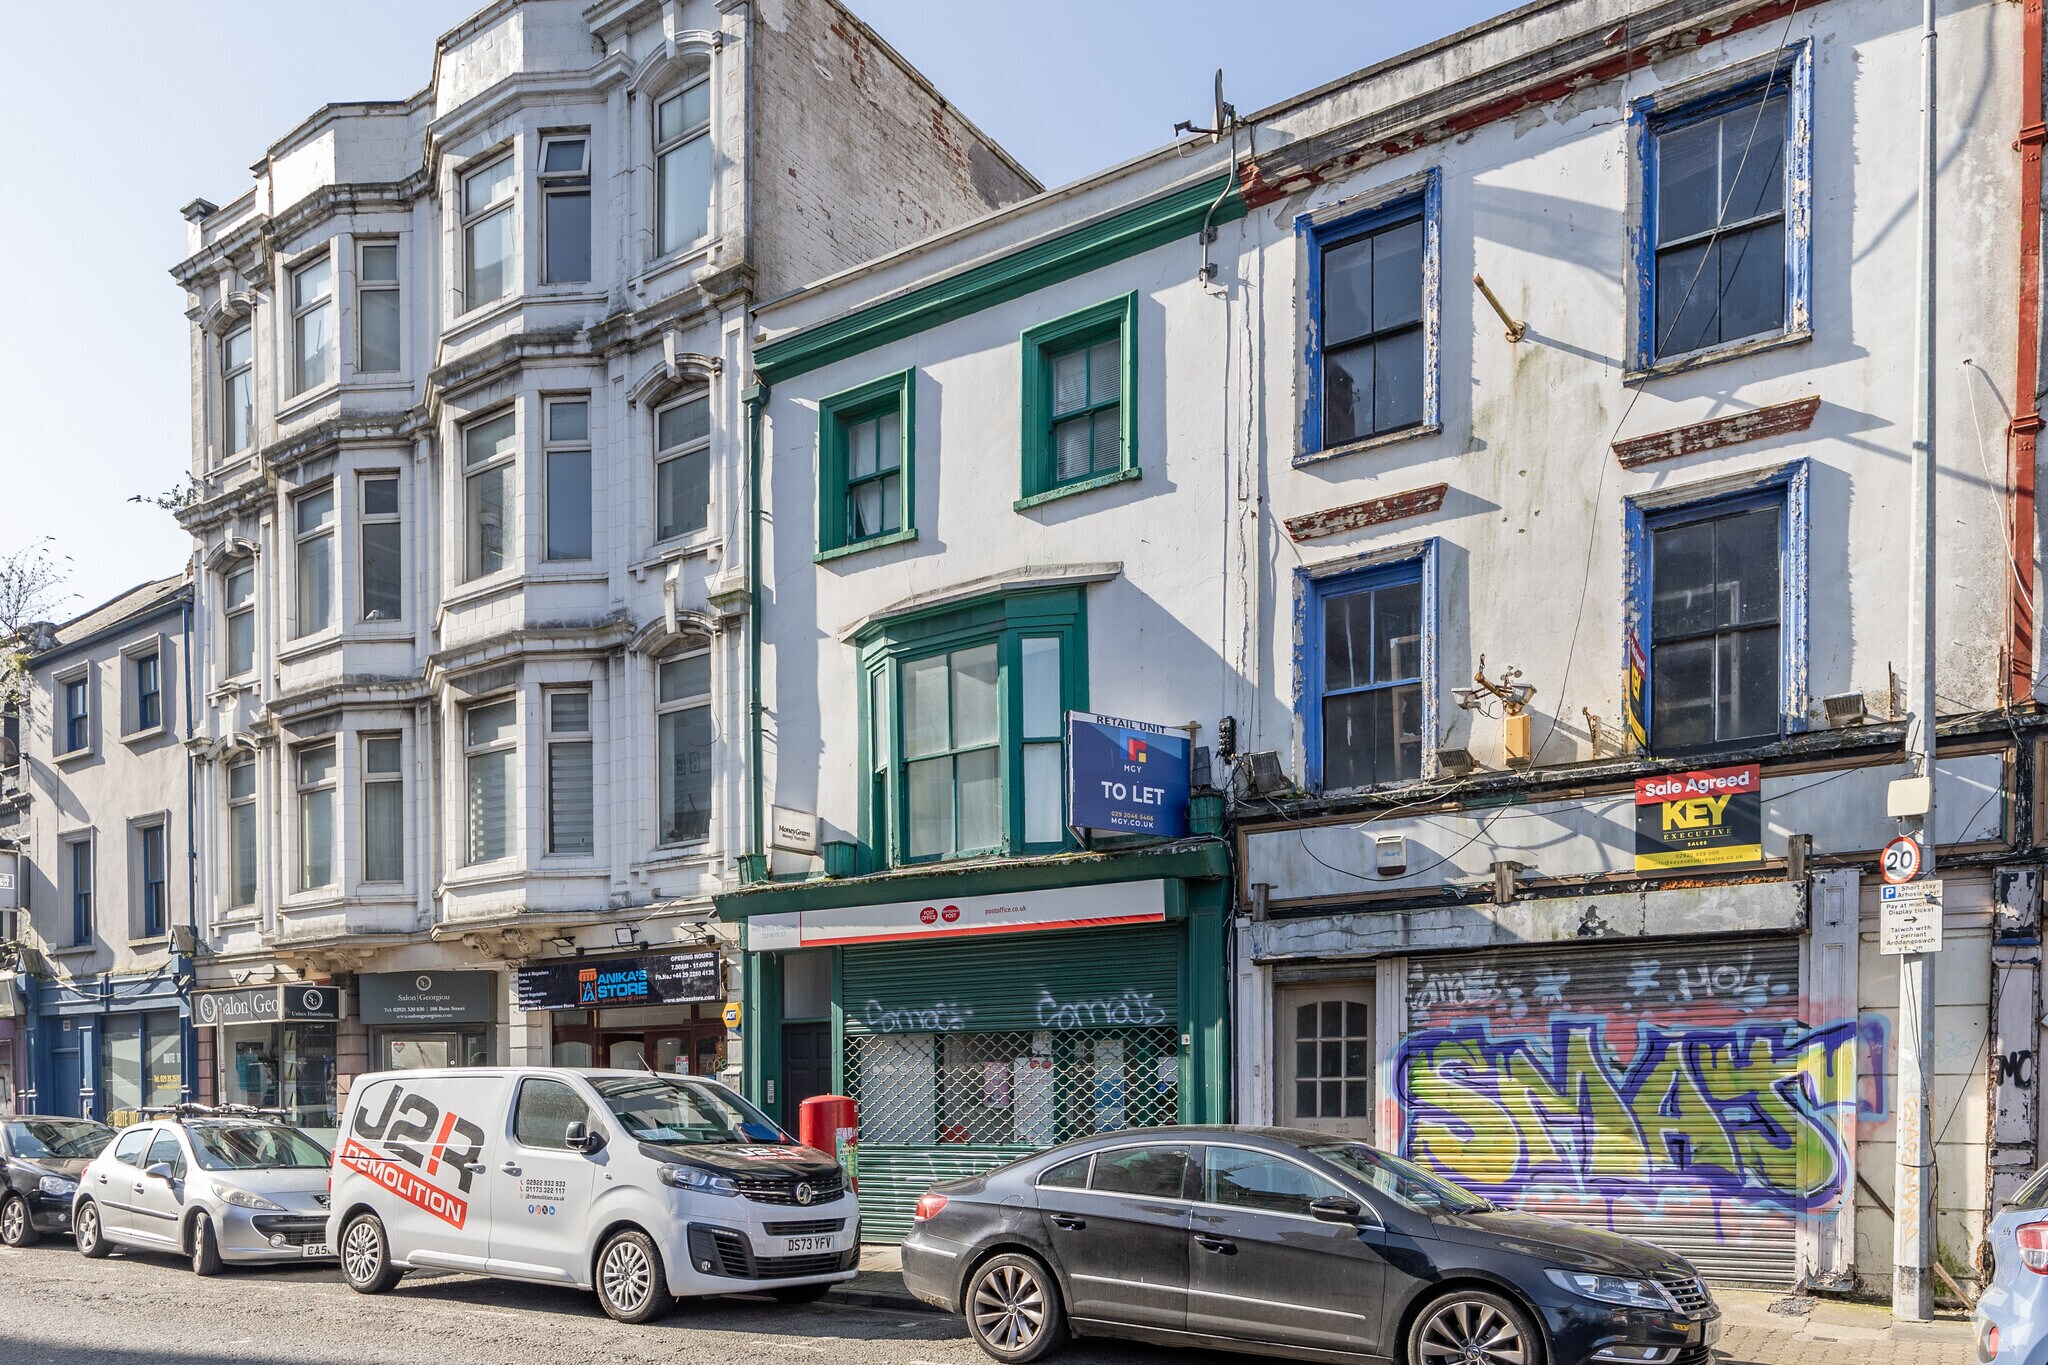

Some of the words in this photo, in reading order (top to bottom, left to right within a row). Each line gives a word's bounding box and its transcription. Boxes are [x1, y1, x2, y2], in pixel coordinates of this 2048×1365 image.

[1097, 715, 1136, 730] RETAIL
[1140, 723, 1166, 734] UNIT
[1124, 764, 1142, 773] MGY
[1645, 780, 1682, 797] Sale
[1685, 771, 1750, 794] Agreed
[1101, 781, 1127, 800] TO
[1132, 785, 1165, 805] LET
[1662, 794, 1732, 830] KEY
[1111, 818, 1154, 828] MGY.CO.UK
[778, 825, 810, 837] MoneyGram
[1663, 828, 1732, 840] EXECUTIVE
[1886, 850, 1913, 871] 20
[1886, 888, 1894, 898] P
[985, 905, 1027, 915] postoffice.co.uk
[1886, 938, 1936, 946] Arddangoswch
[670, 954, 693, 962] OPENING
[694, 952, 714, 960] HOURS:
[597, 970, 647, 985] ANIKA'S
[598, 981, 648, 998] STORE
[254, 993, 279, 1013] Geo
[398, 994, 416, 1002] Salon
[419, 994, 450, 1002] Georgiou
[663, 995, 715, 1003] www.anikasstore.com
[346, 1144, 462, 1223] DEMOLITION
[788, 1238, 812, 1252] DS73
[814, 1236, 831, 1250] YFV
